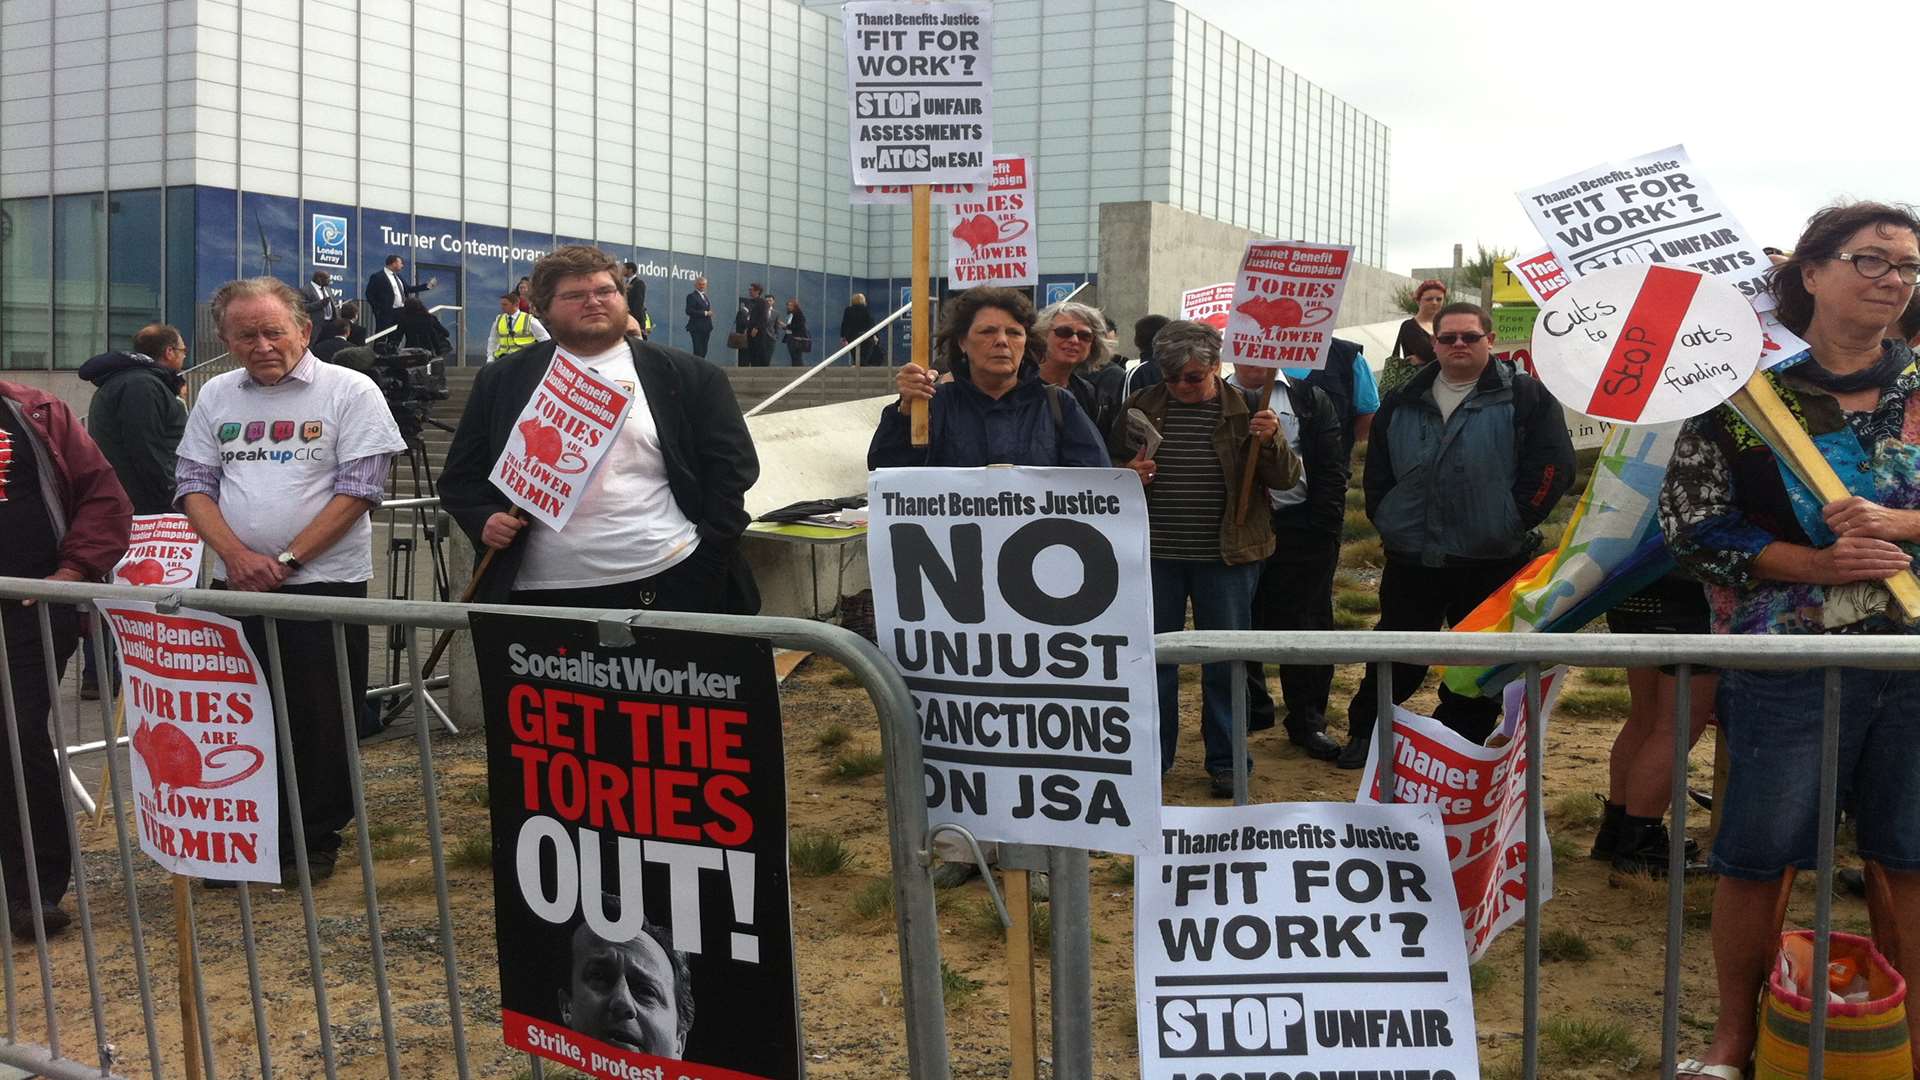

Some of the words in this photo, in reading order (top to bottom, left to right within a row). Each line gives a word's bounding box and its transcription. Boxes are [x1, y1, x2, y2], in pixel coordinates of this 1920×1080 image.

[855, 13, 894, 26] Thanet
[895, 13, 939, 26] Benefits
[940, 13, 979, 26] Justice
[857, 30, 907, 51] 'FIT
[918, 30, 979, 51] FOR
[857, 55, 977, 77] WORK'?
[857, 91, 920, 116] STOP
[924, 98, 983, 115] UNFAIR
[860, 124, 983, 141] ASSESSMENTS
[861, 157, 876, 169] BY
[877, 148, 930, 170] ATOS
[932, 156, 947, 168] ON
[949, 151, 983, 168] ESA!
[993, 175, 1023, 187] paign
[1532, 184, 1581, 207] Thanet
[1578, 170, 1634, 193] Benefits
[1634, 160, 1680, 178] Justice
[1542, 193, 1606, 226] 'FIT
[1615, 173, 1695, 204] FOR
[998, 213, 1016, 221] ARE
[380, 225, 436, 249] Turner
[1660, 228, 1740, 257] UNFAIR
[317, 246, 343, 256] London
[320, 254, 340, 264] Array
[974, 246, 1027, 260] LOWER
[1250, 247, 1288, 260] Thanet
[1292, 249, 1332, 263] Benefit
[955, 262, 1026, 281] VERMIN
[1247, 258, 1285, 271] Justice
[1288, 262, 1341, 275] Campaign
[1521, 259, 1561, 279] Tha
[1246, 275, 1335, 298] TORIES
[1187, 303, 1232, 317] TORI
[1304, 299, 1323, 307] ARE
[1543, 298, 1617, 337] Cuts
[1234, 333, 1263, 342] THAN
[1263, 326, 1323, 343] LOWER
[1584, 327, 1608, 343] to
[1680, 323, 1733, 348] arts
[1232, 341, 1320, 362] VERMIN
[553, 357, 576, 383] Thanet
[576, 373, 613, 405] Benefit
[1663, 359, 1738, 394] funding
[547, 371, 569, 396] Justice
[567, 388, 616, 424] Campaign
[533, 391, 604, 448] TORIES
[565, 440, 584, 455] ARE
[500, 461, 565, 518] VERMIN
[524, 457, 572, 498] LOWER
[882, 492, 946, 517] Thanet
[948, 491, 1035, 517] Benefits
[1039, 489, 1120, 515] Justice
[153, 530, 197, 540] Campaign
[156, 520, 188, 529] Benefit
[126, 545, 192, 560] TORIES
[165, 561, 183, 569] ARE
[889, 518, 1119, 626] NO
[112, 614, 154, 640] Thanet
[157, 621, 225, 648] Benefit
[121, 635, 154, 664] Justice
[157, 648, 250, 674] Campaign
[894, 628, 1128, 681] UNJUST
[130, 675, 253, 725] TORIES
[200, 731, 238, 746] ARE
[508, 684, 605, 755] GET
[618, 701, 750, 773] THE
[155, 788, 259, 823] LOWER
[511, 744, 754, 846] TORIES
[1011, 774, 1131, 827] JSA
[1393, 773, 1472, 815] ustice
[141, 808, 258, 864] VERMIN
[1162, 828, 1239, 855] Thanet
[1241, 824, 1336, 851] Benefits
[1340, 823, 1420, 851] Justice
[516, 815, 760, 963] OUT!
[1161, 861, 1267, 907] 'FIT
[1292, 858, 1433, 904] FOR
[1158, 911, 1429, 963] WORK'?
[1161, 996, 1302, 1053] STOP
[1314, 1009, 1454, 1049] UNFAIR
[527, 1024, 586, 1067] Strike,
